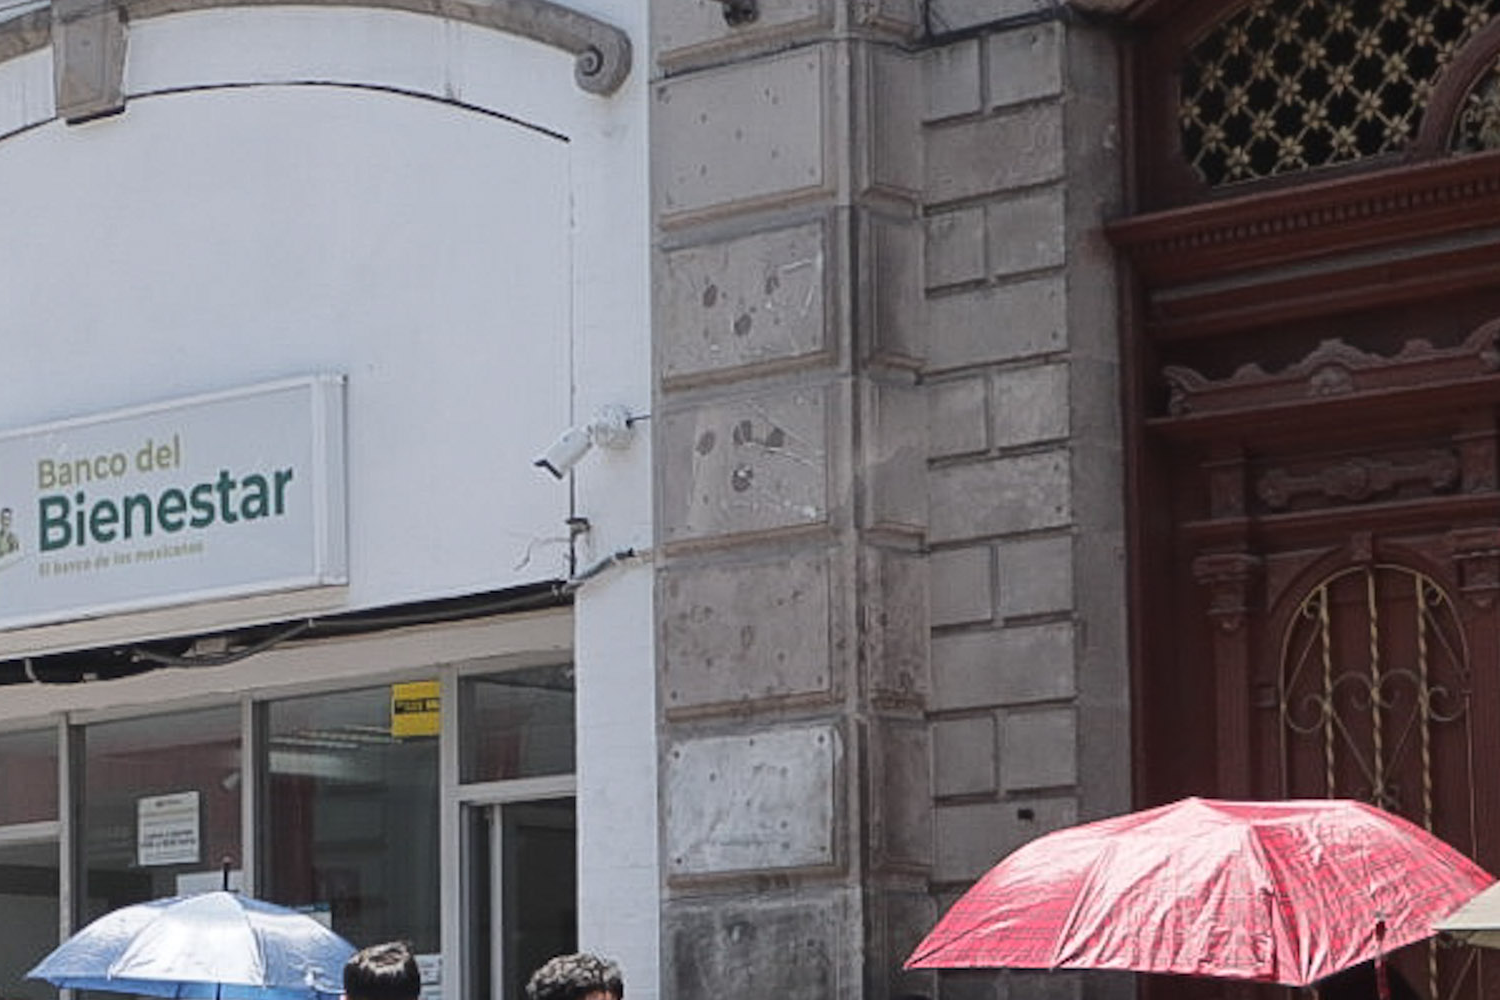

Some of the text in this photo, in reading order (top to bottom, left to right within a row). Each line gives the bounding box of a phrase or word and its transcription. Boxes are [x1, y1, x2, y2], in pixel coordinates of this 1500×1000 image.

[37, 433, 181, 489] Banco del
[38, 466, 293, 552] Bienestar
